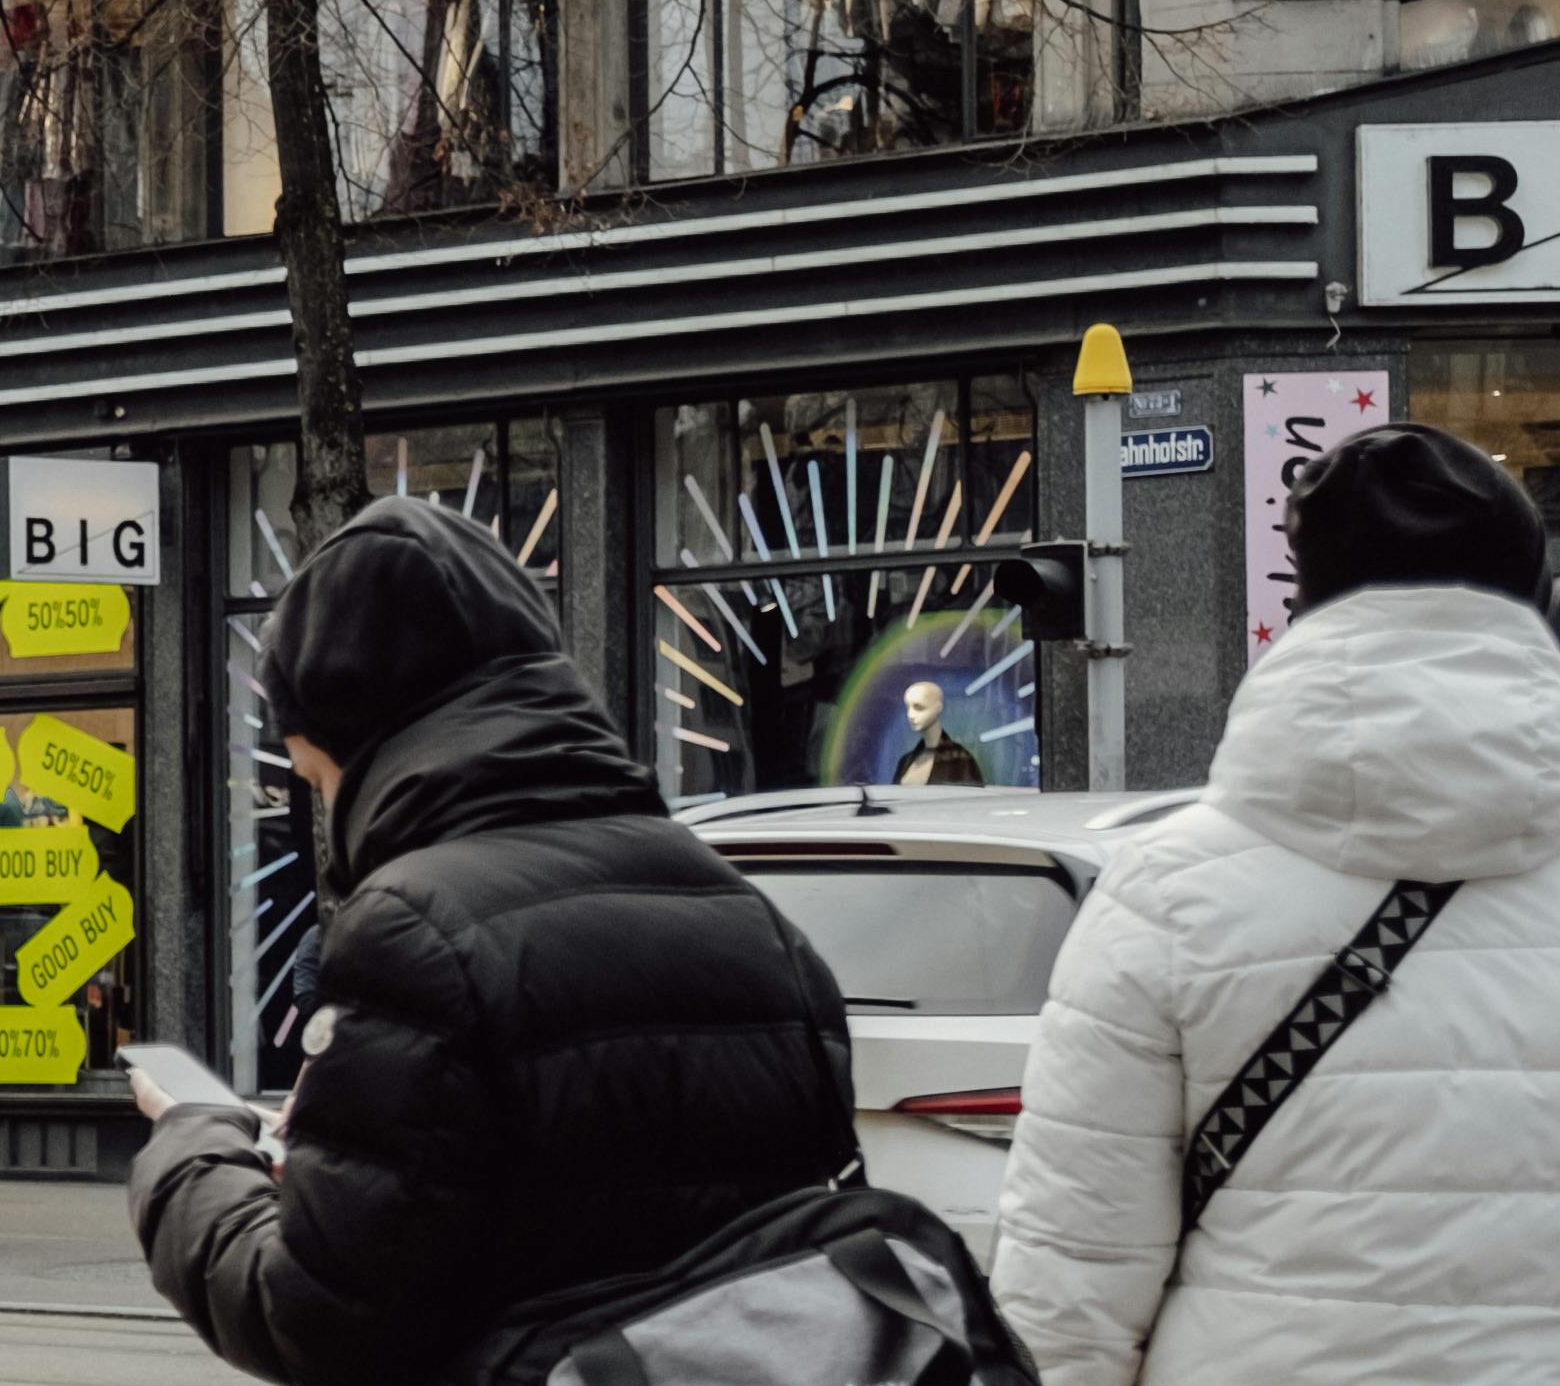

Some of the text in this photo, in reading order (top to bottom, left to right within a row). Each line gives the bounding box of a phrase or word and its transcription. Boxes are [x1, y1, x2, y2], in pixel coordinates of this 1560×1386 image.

[1121, 432, 1204, 467] ahnhofstr.
[46, 850, 83, 877] BUY
[31, 897, 119, 989] GOOD BUY
